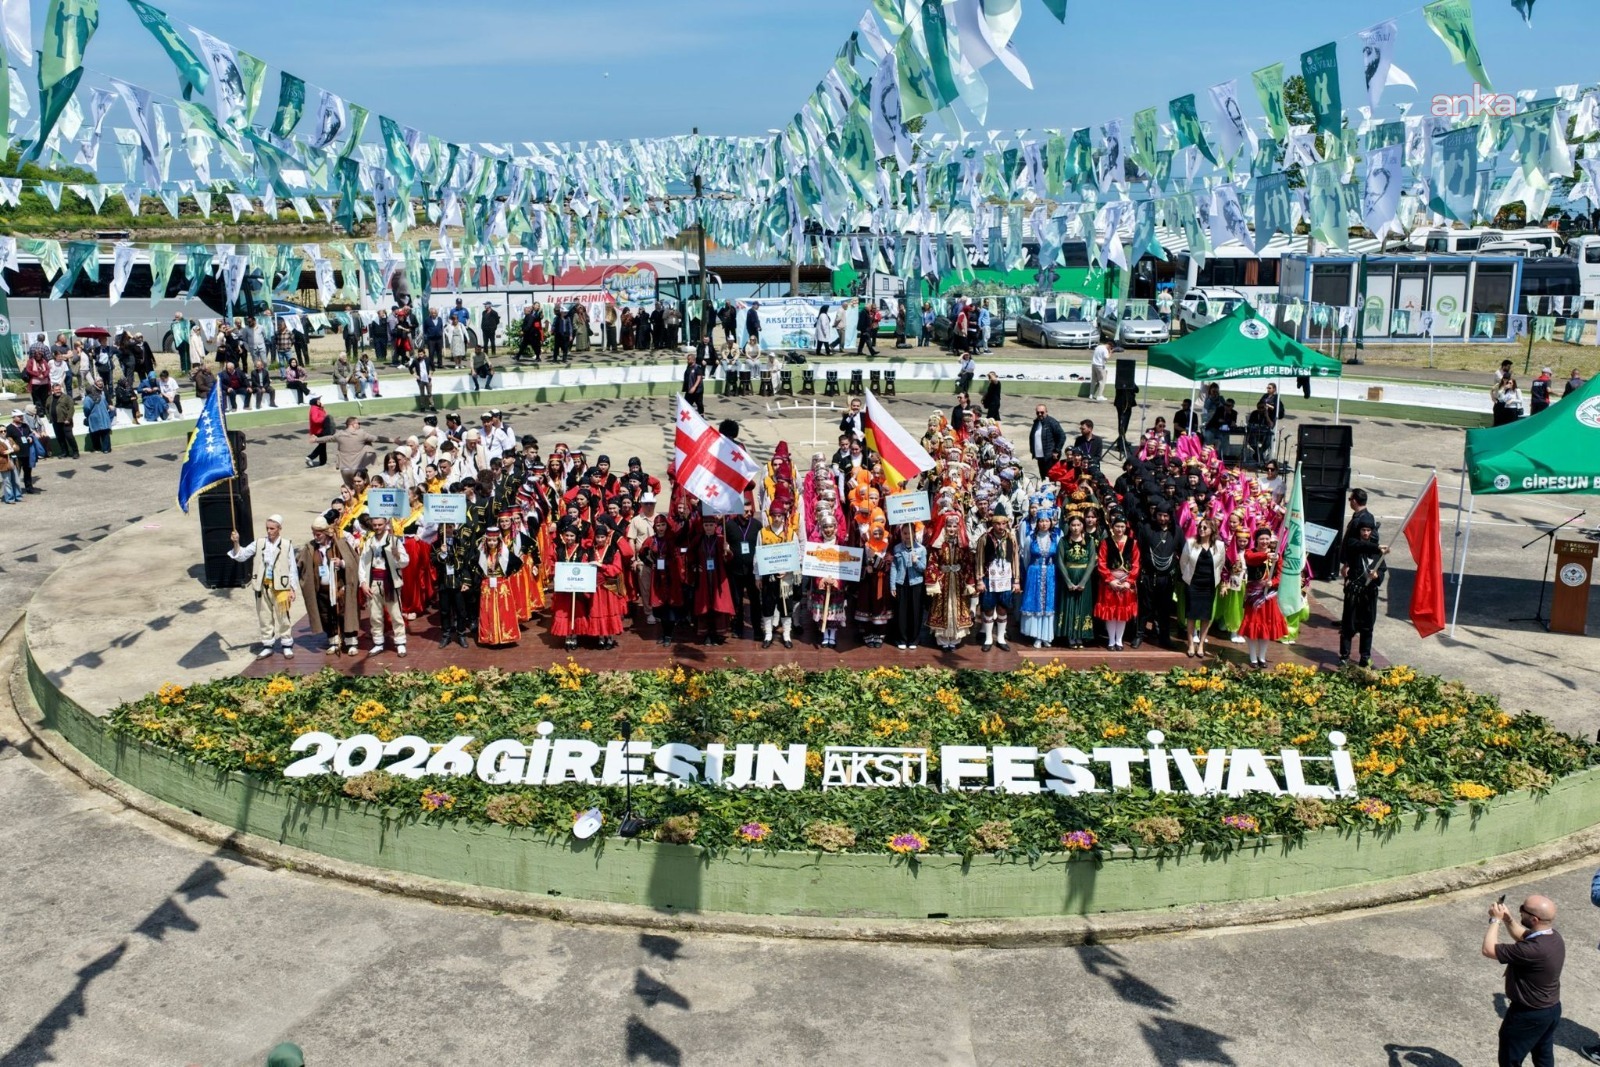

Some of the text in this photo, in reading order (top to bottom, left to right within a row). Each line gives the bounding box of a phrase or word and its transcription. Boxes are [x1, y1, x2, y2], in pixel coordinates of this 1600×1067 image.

[1223, 364, 1312, 378] GİRESUN BELEDİYESİ
[1522, 474, 1589, 489] GİRESUN
[283, 721, 1358, 799] 2026 GİRESUN AKSU FESTİVALİ
